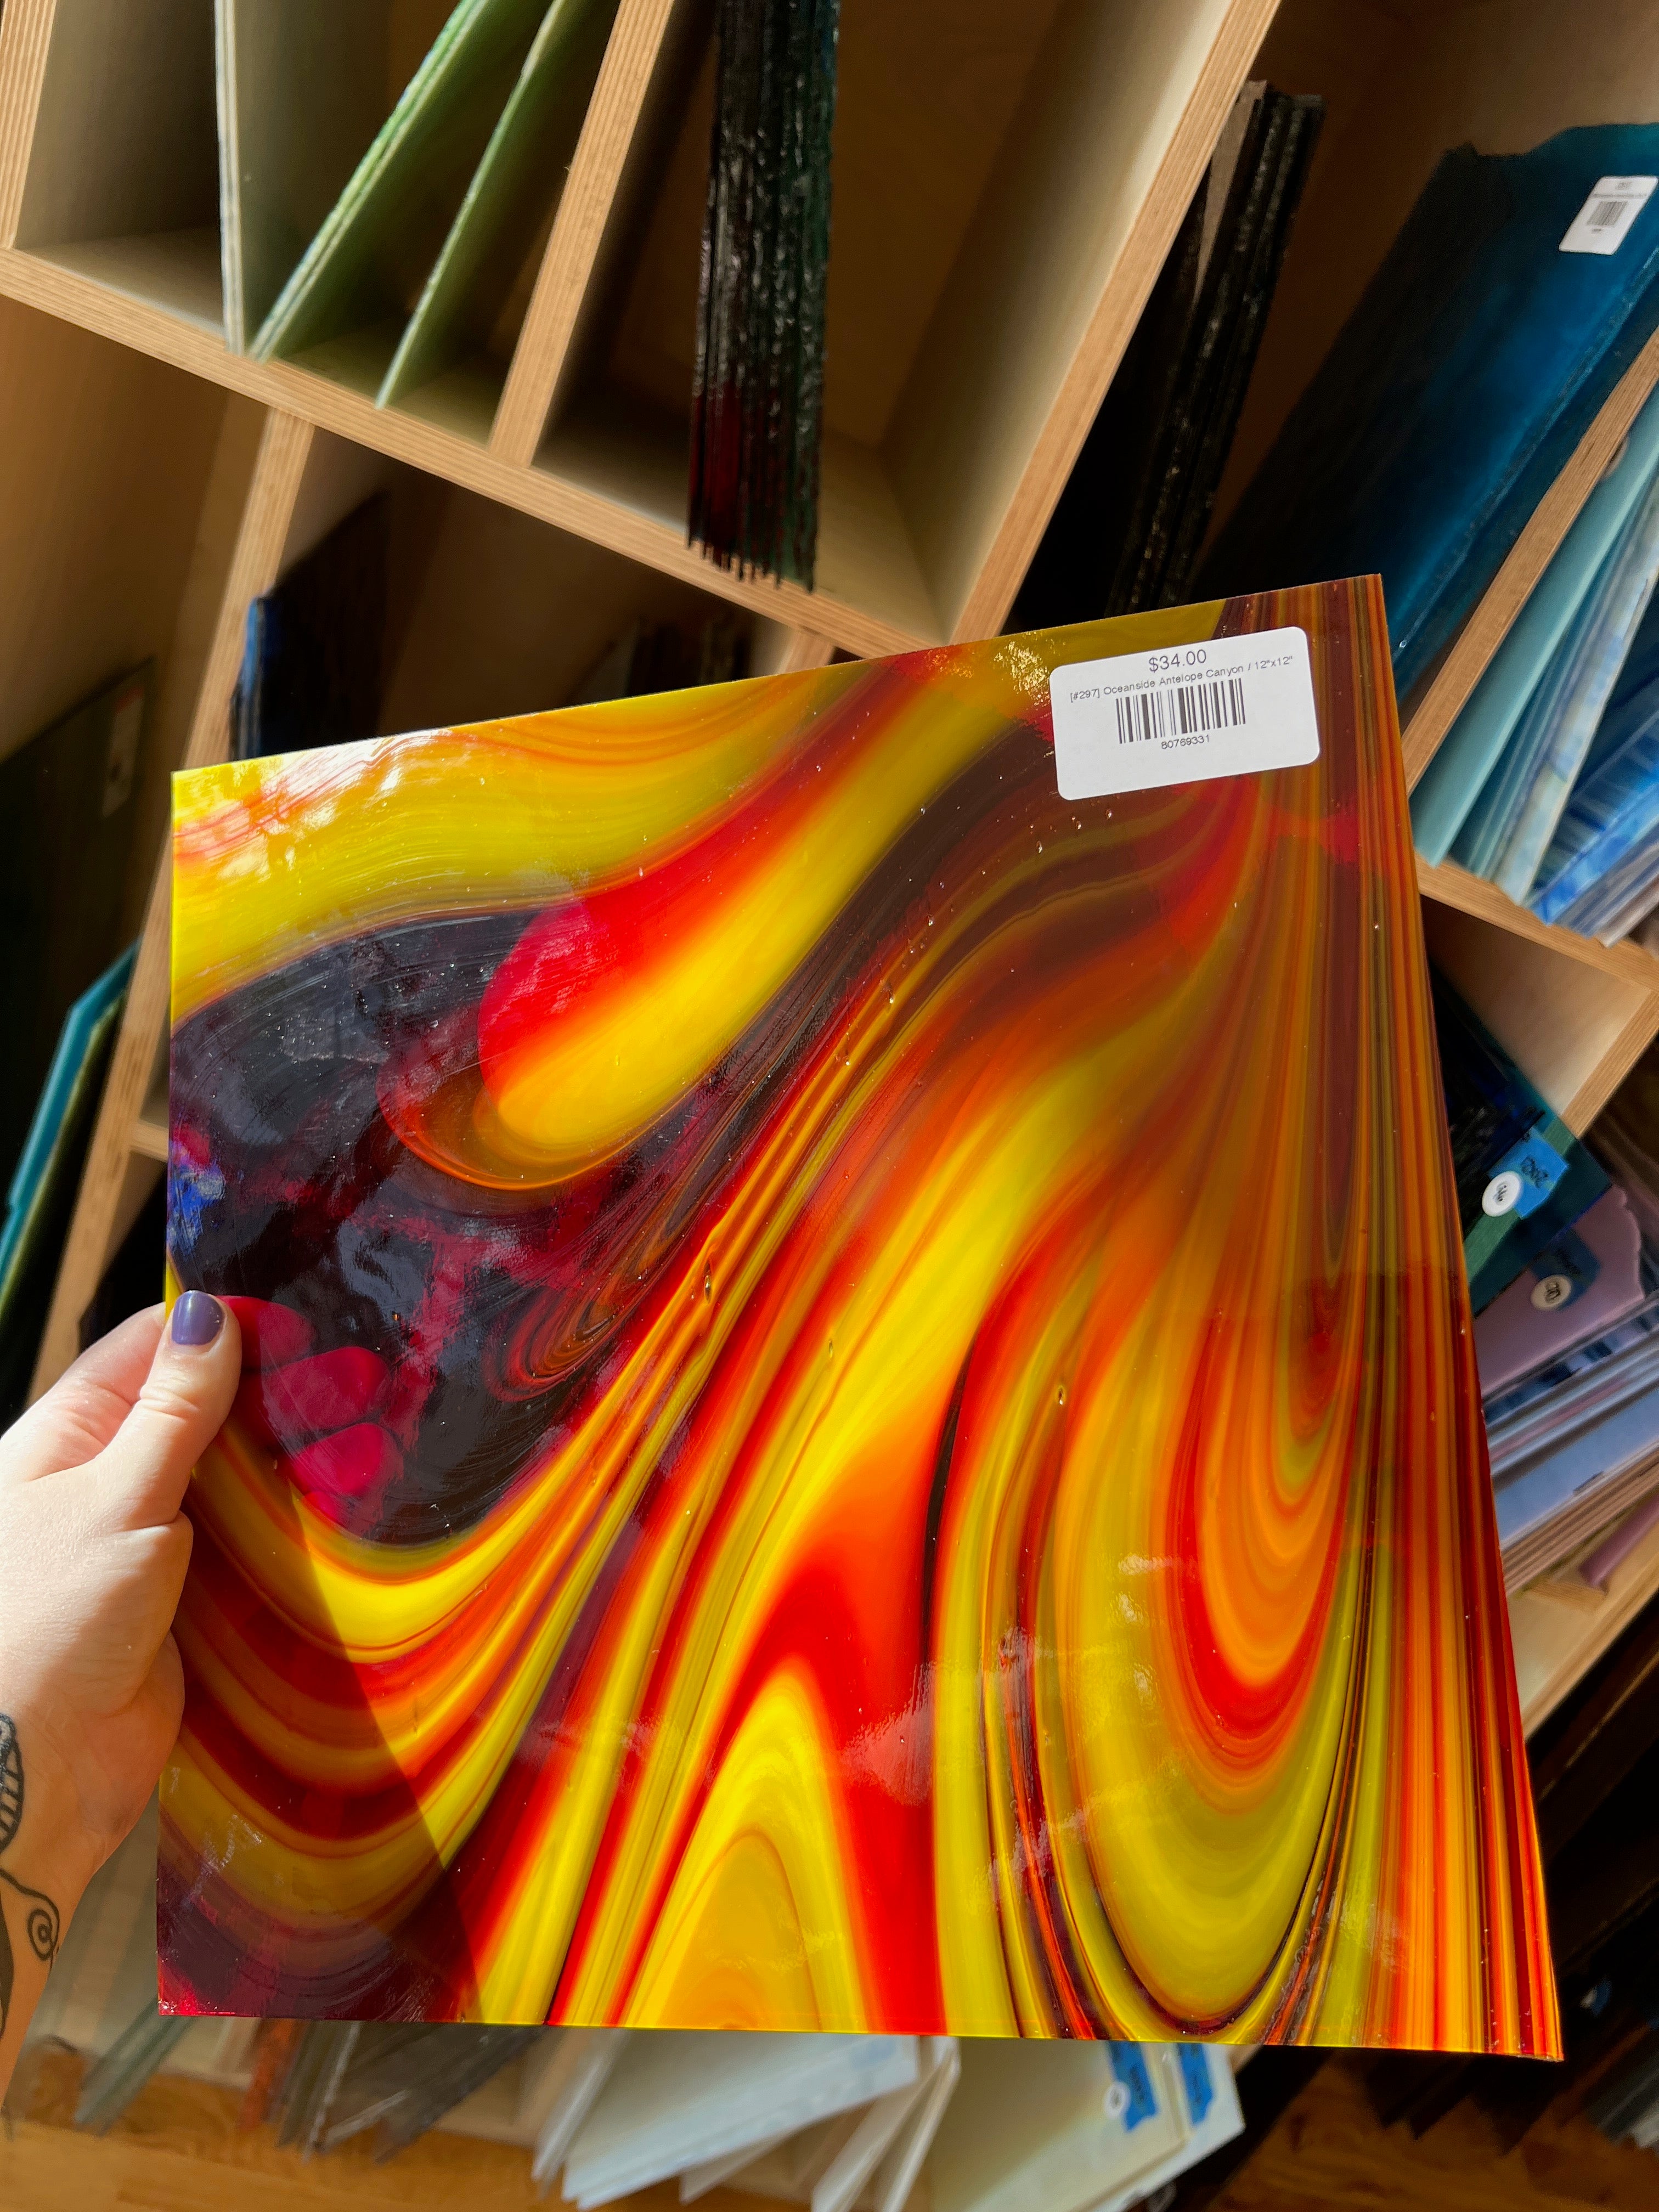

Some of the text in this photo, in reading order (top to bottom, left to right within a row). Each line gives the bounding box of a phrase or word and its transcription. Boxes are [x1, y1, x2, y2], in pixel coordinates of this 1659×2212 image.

[1149, 649, 1207, 673] $34.00
[1070, 656, 1293, 703] [#297] Oceanside Antelope Canyon / 12"x12"
[1161, 734, 1210, 749] 80769331
